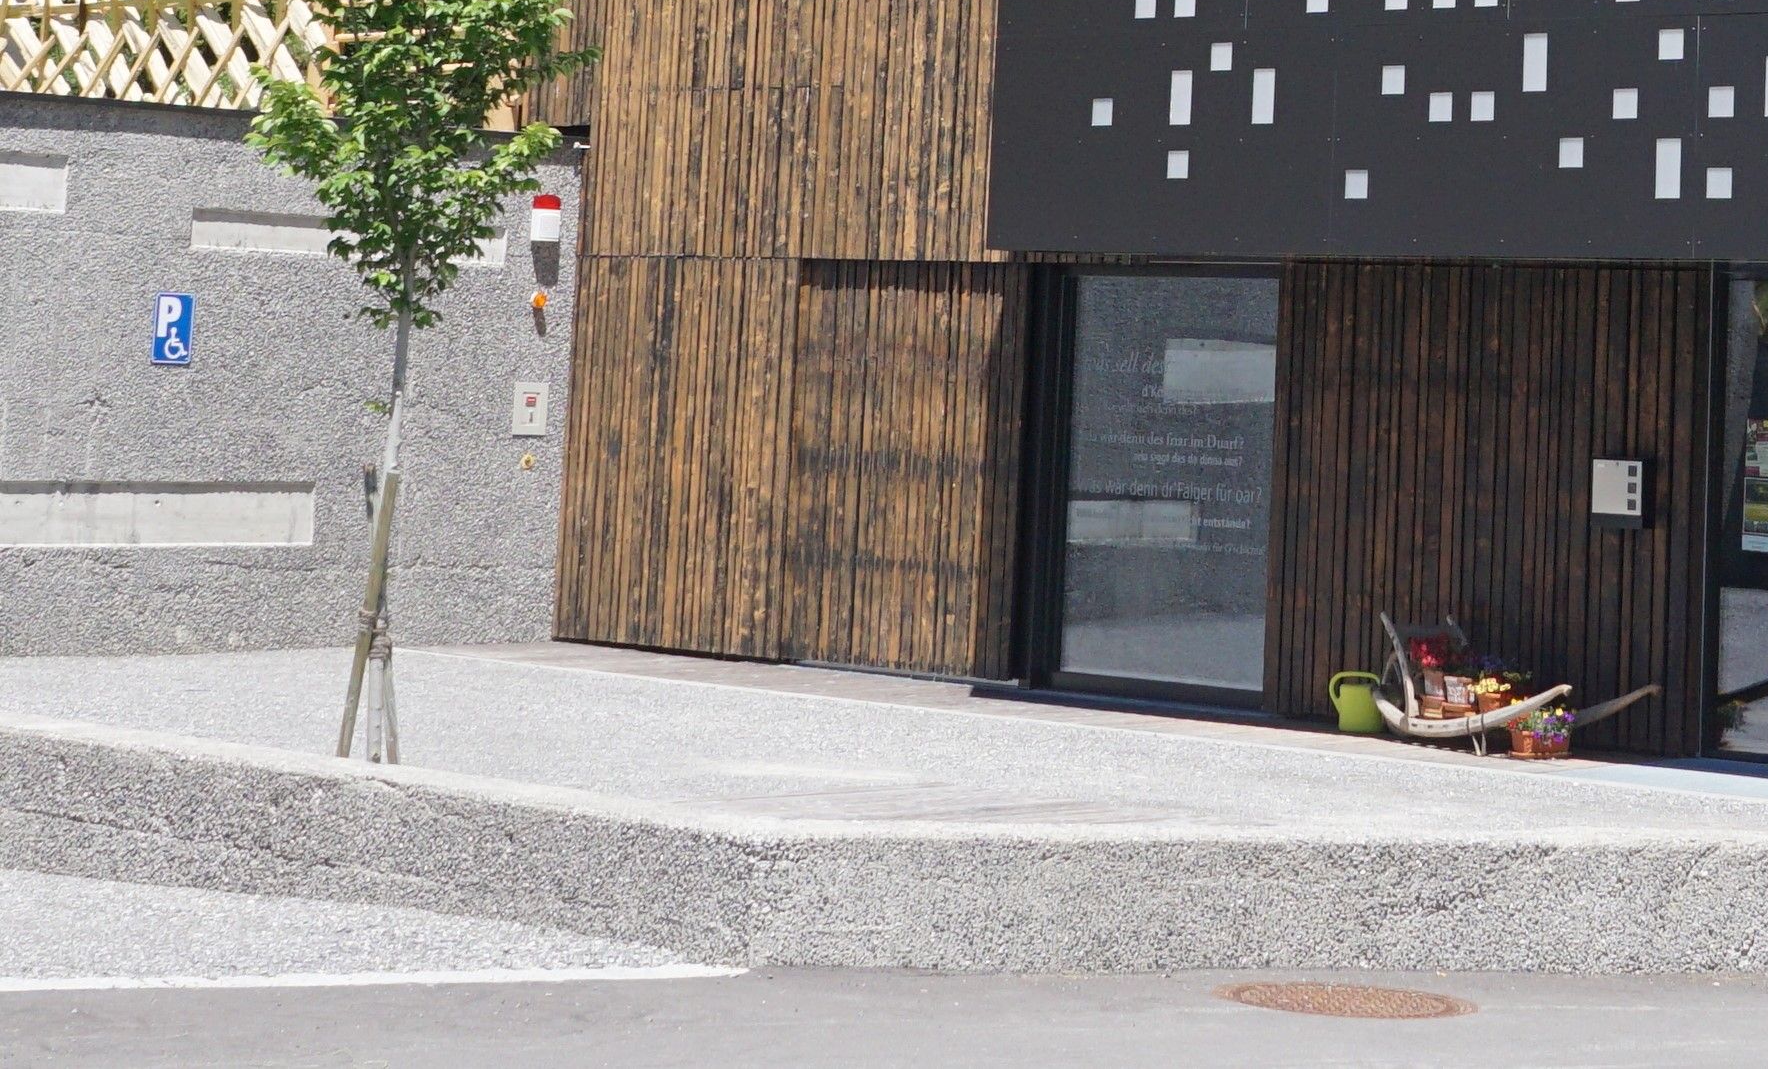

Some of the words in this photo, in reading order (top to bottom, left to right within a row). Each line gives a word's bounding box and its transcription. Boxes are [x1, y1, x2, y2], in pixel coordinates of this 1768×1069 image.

[156, 296, 183, 338] P
[1129, 478, 1158, 498] denn
[1215, 482, 1232, 502] für
